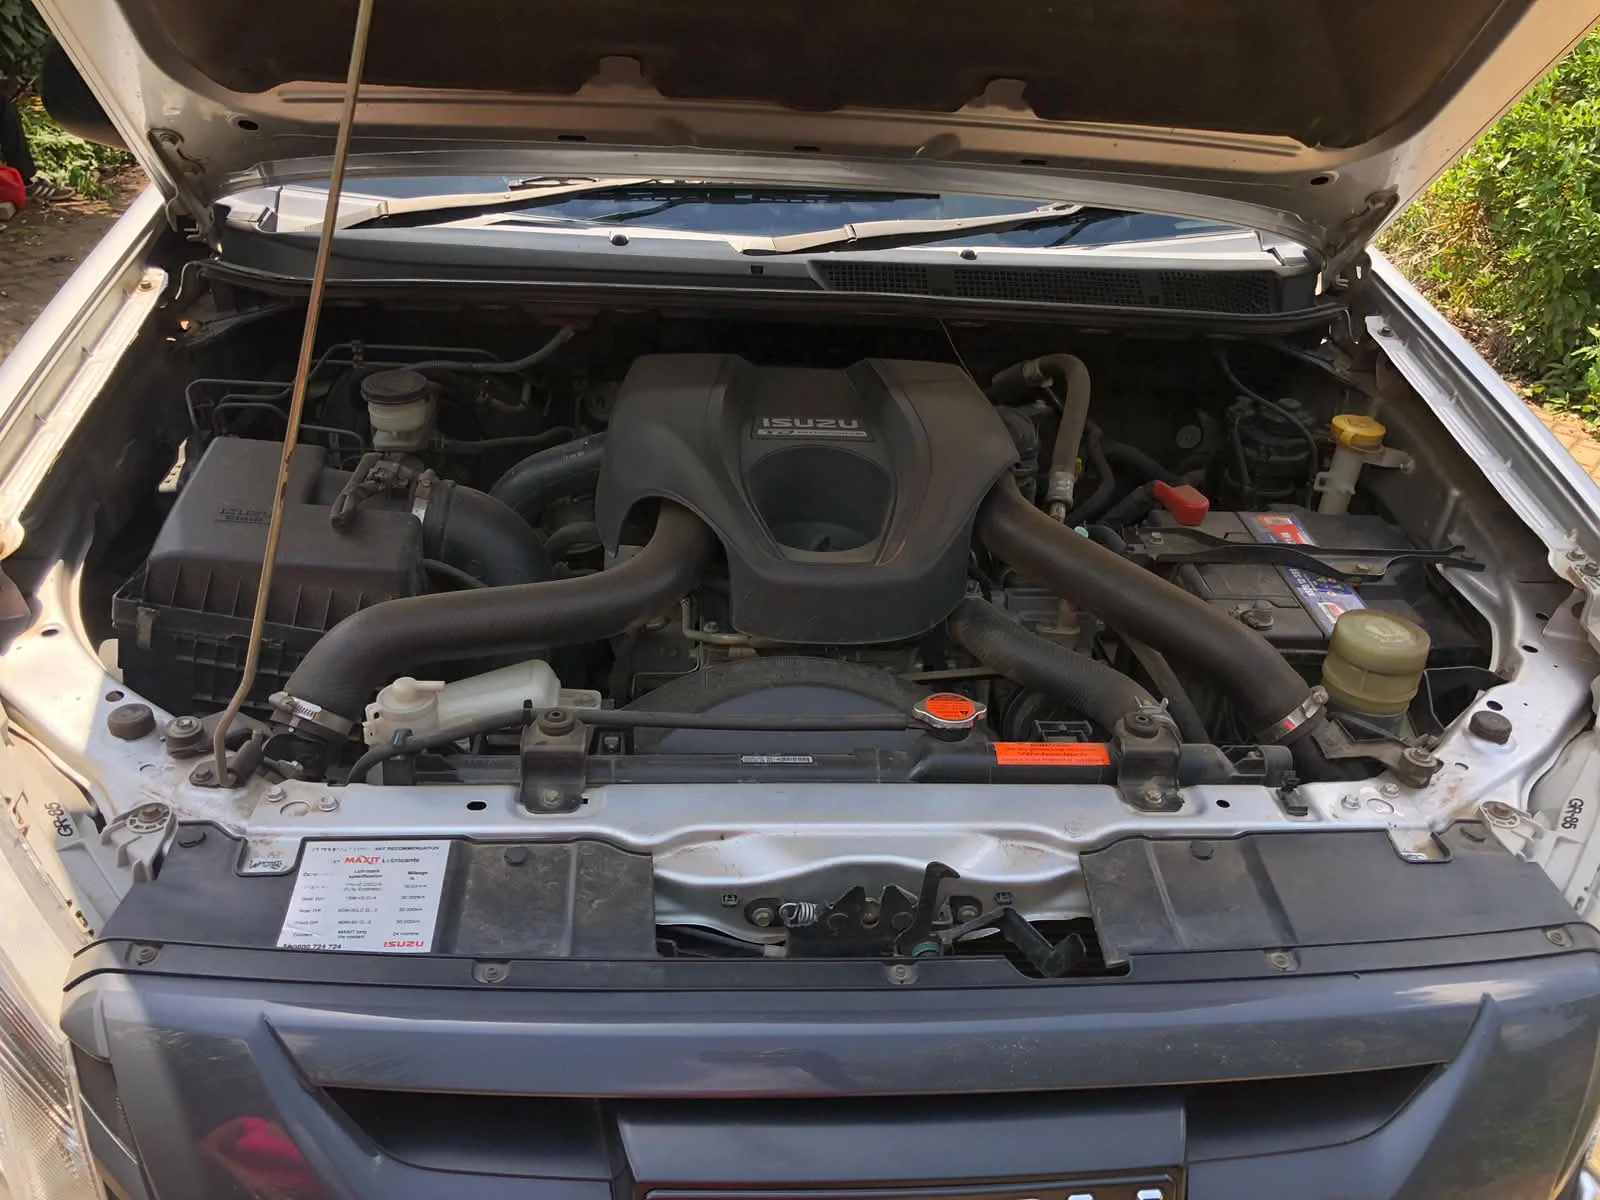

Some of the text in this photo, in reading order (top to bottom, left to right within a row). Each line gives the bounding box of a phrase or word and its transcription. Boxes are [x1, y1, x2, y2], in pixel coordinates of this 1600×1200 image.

[763, 418, 859, 428] ISUZU
[1561, 798, 1584, 830] GR-85
[44, 802, 73, 837] GR-85
[344, 855, 380, 865] MAXIT
[383, 940, 425, 948] ISUZU
